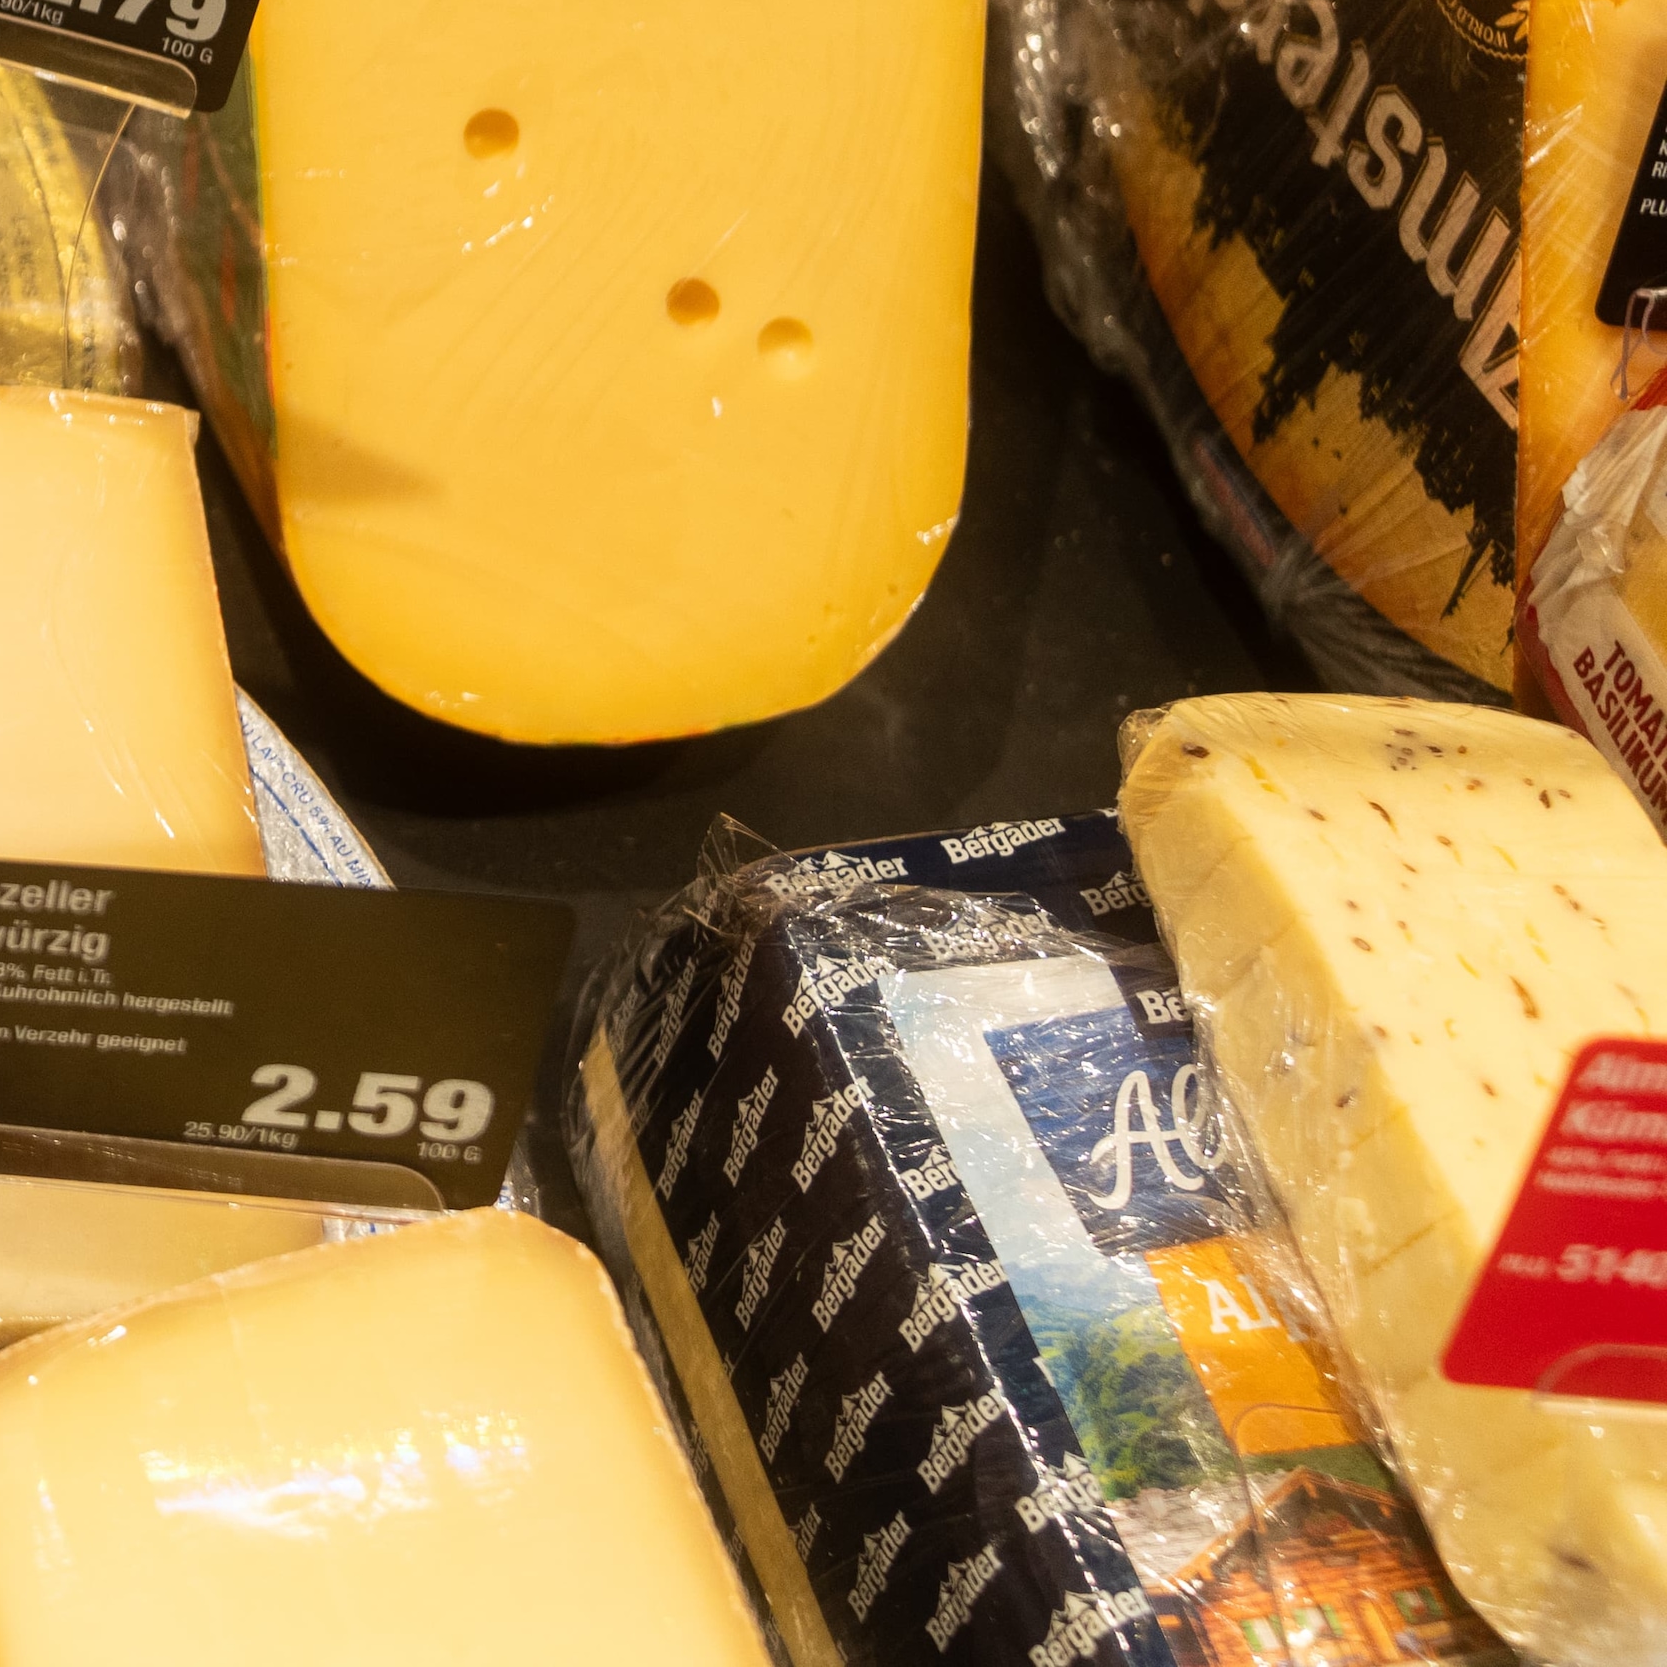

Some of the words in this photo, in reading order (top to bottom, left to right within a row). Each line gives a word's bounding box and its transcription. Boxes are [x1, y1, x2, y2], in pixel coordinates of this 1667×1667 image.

[161, 37, 195, 59] 100
[199, 47, 214, 65] G
[282, 772, 314, 806] CRU
[767, 854, 909, 900] Bergader
[940, 818, 1065, 864] Bergader
[184, 1120, 299, 1149] 25.90/1kg
[241, 1064, 494, 1142] 2.59
[723, 1065, 778, 1187] Bergader
[791, 1076, 874, 1193] Bergader
[811, 1212, 887, 1332] Bergader
[824, 1371, 894, 1481] Bergader
[917, 1388, 1008, 1494] Bergader
[848, 1511, 913, 1623] Bergader
